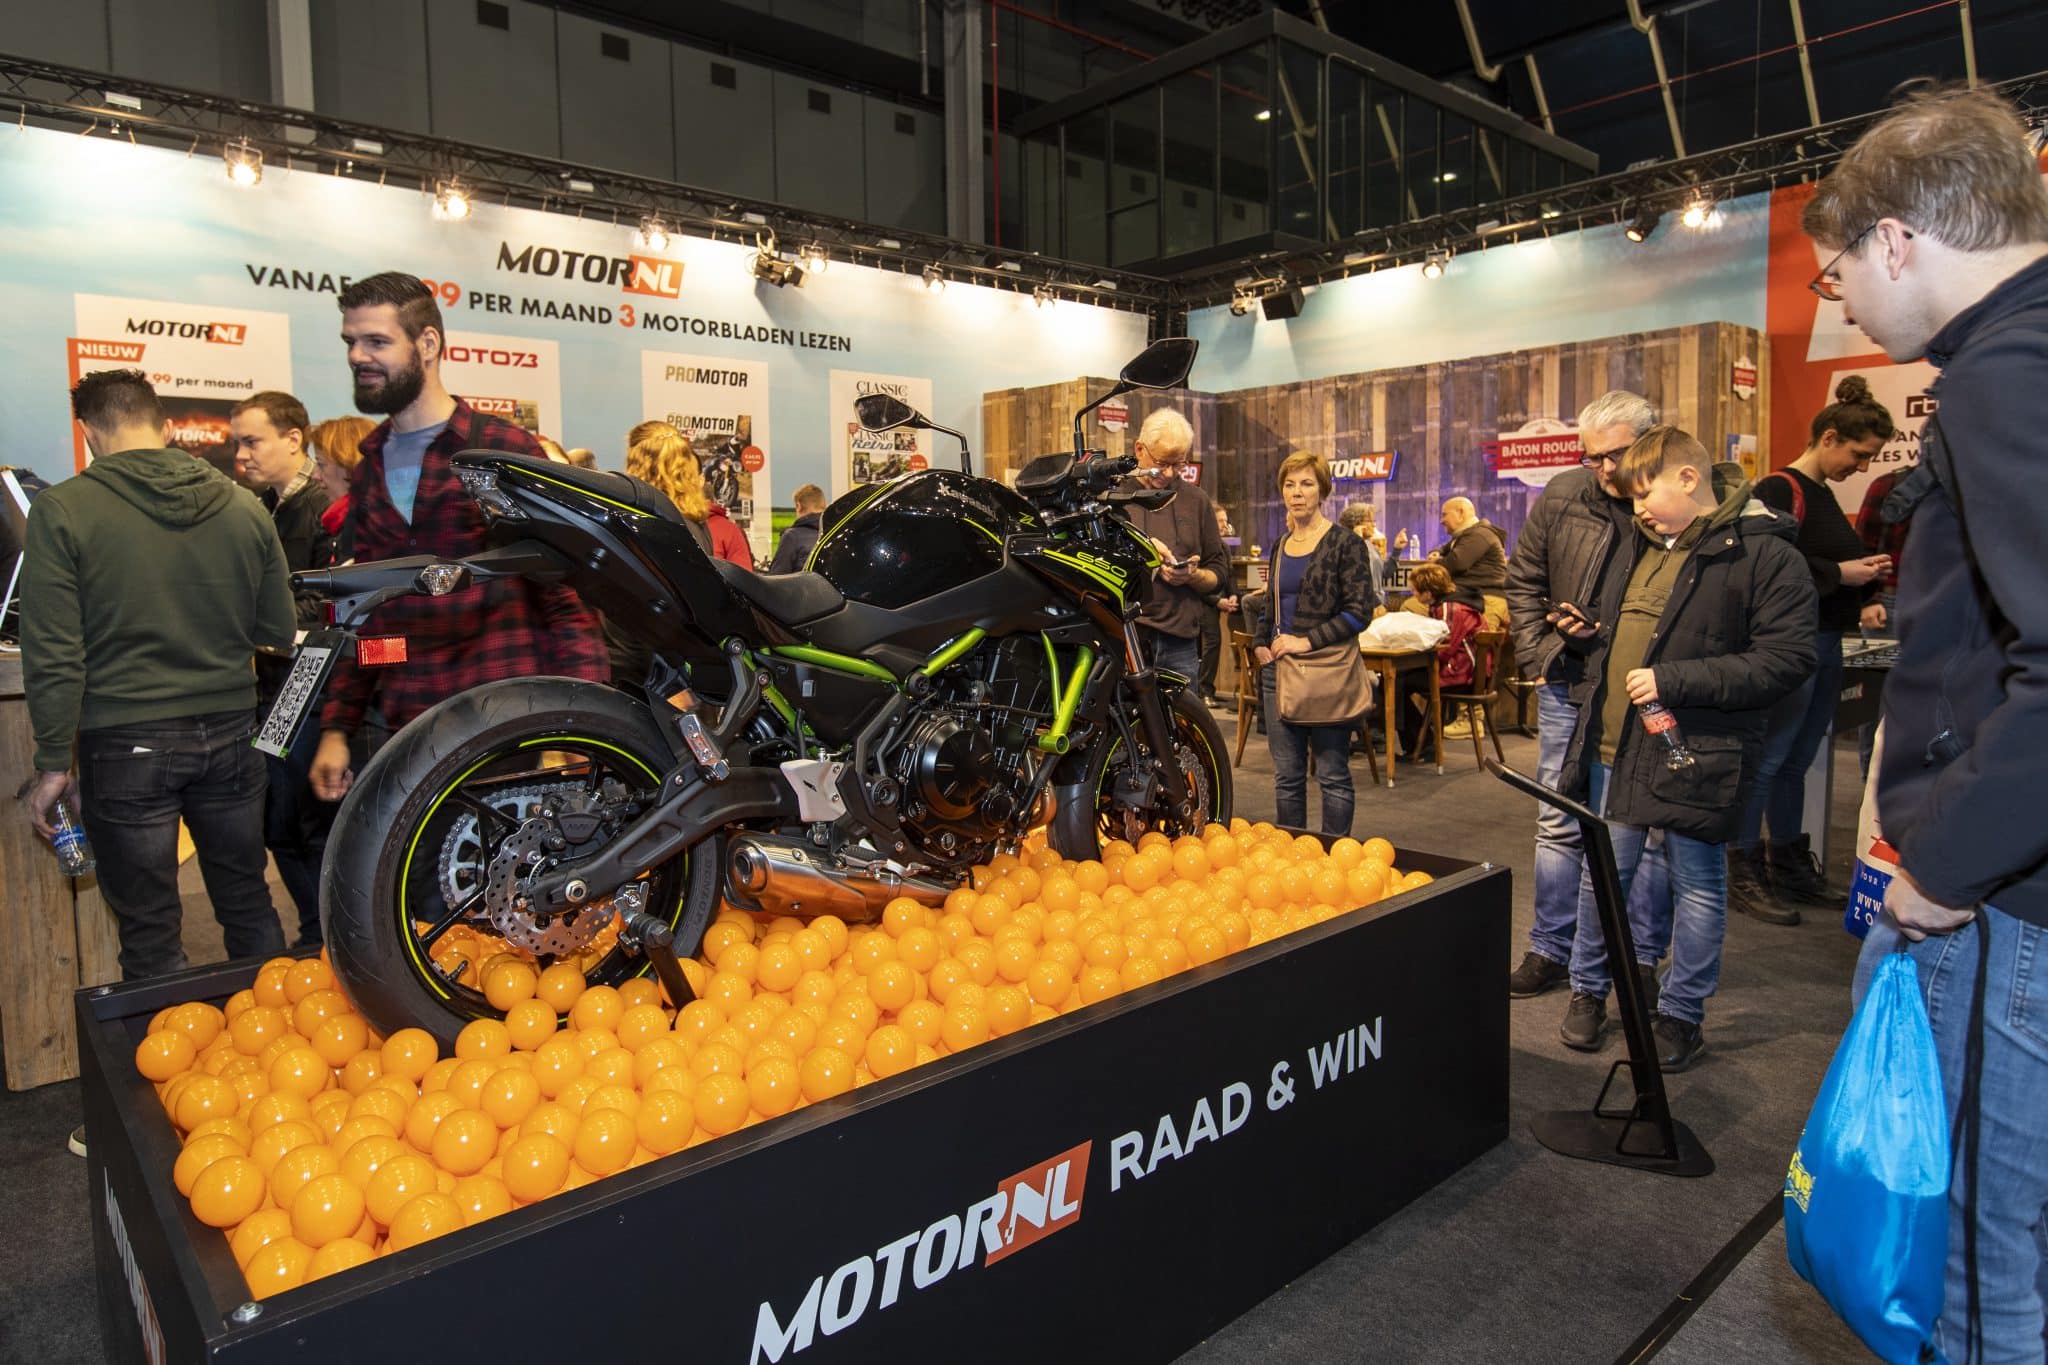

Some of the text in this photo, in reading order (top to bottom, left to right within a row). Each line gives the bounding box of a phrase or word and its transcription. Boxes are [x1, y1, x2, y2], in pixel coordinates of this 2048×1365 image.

[469, 291, 512, 315] PER
[520, 298, 612, 325] MAAND
[619, 304, 636, 328] 3
[642, 312, 795, 346] MOTORBLADEN
[800, 331, 852, 353] LEZEN
[77, 343, 139, 359] NIEUW
[176, 377, 201, 388] per
[204, 379, 254, 390] maand
[665, 365, 749, 388] PROMOTOR
[856, 381, 908, 397] CLASSIC
[666, 413, 735, 431] PROMOTOR
[1076, 551, 1128, 578] 650
[1111, 1081, 1252, 1193] RAAD
[1266, 1060, 1296, 1112] &
[1307, 1016, 1383, 1091] WIN
